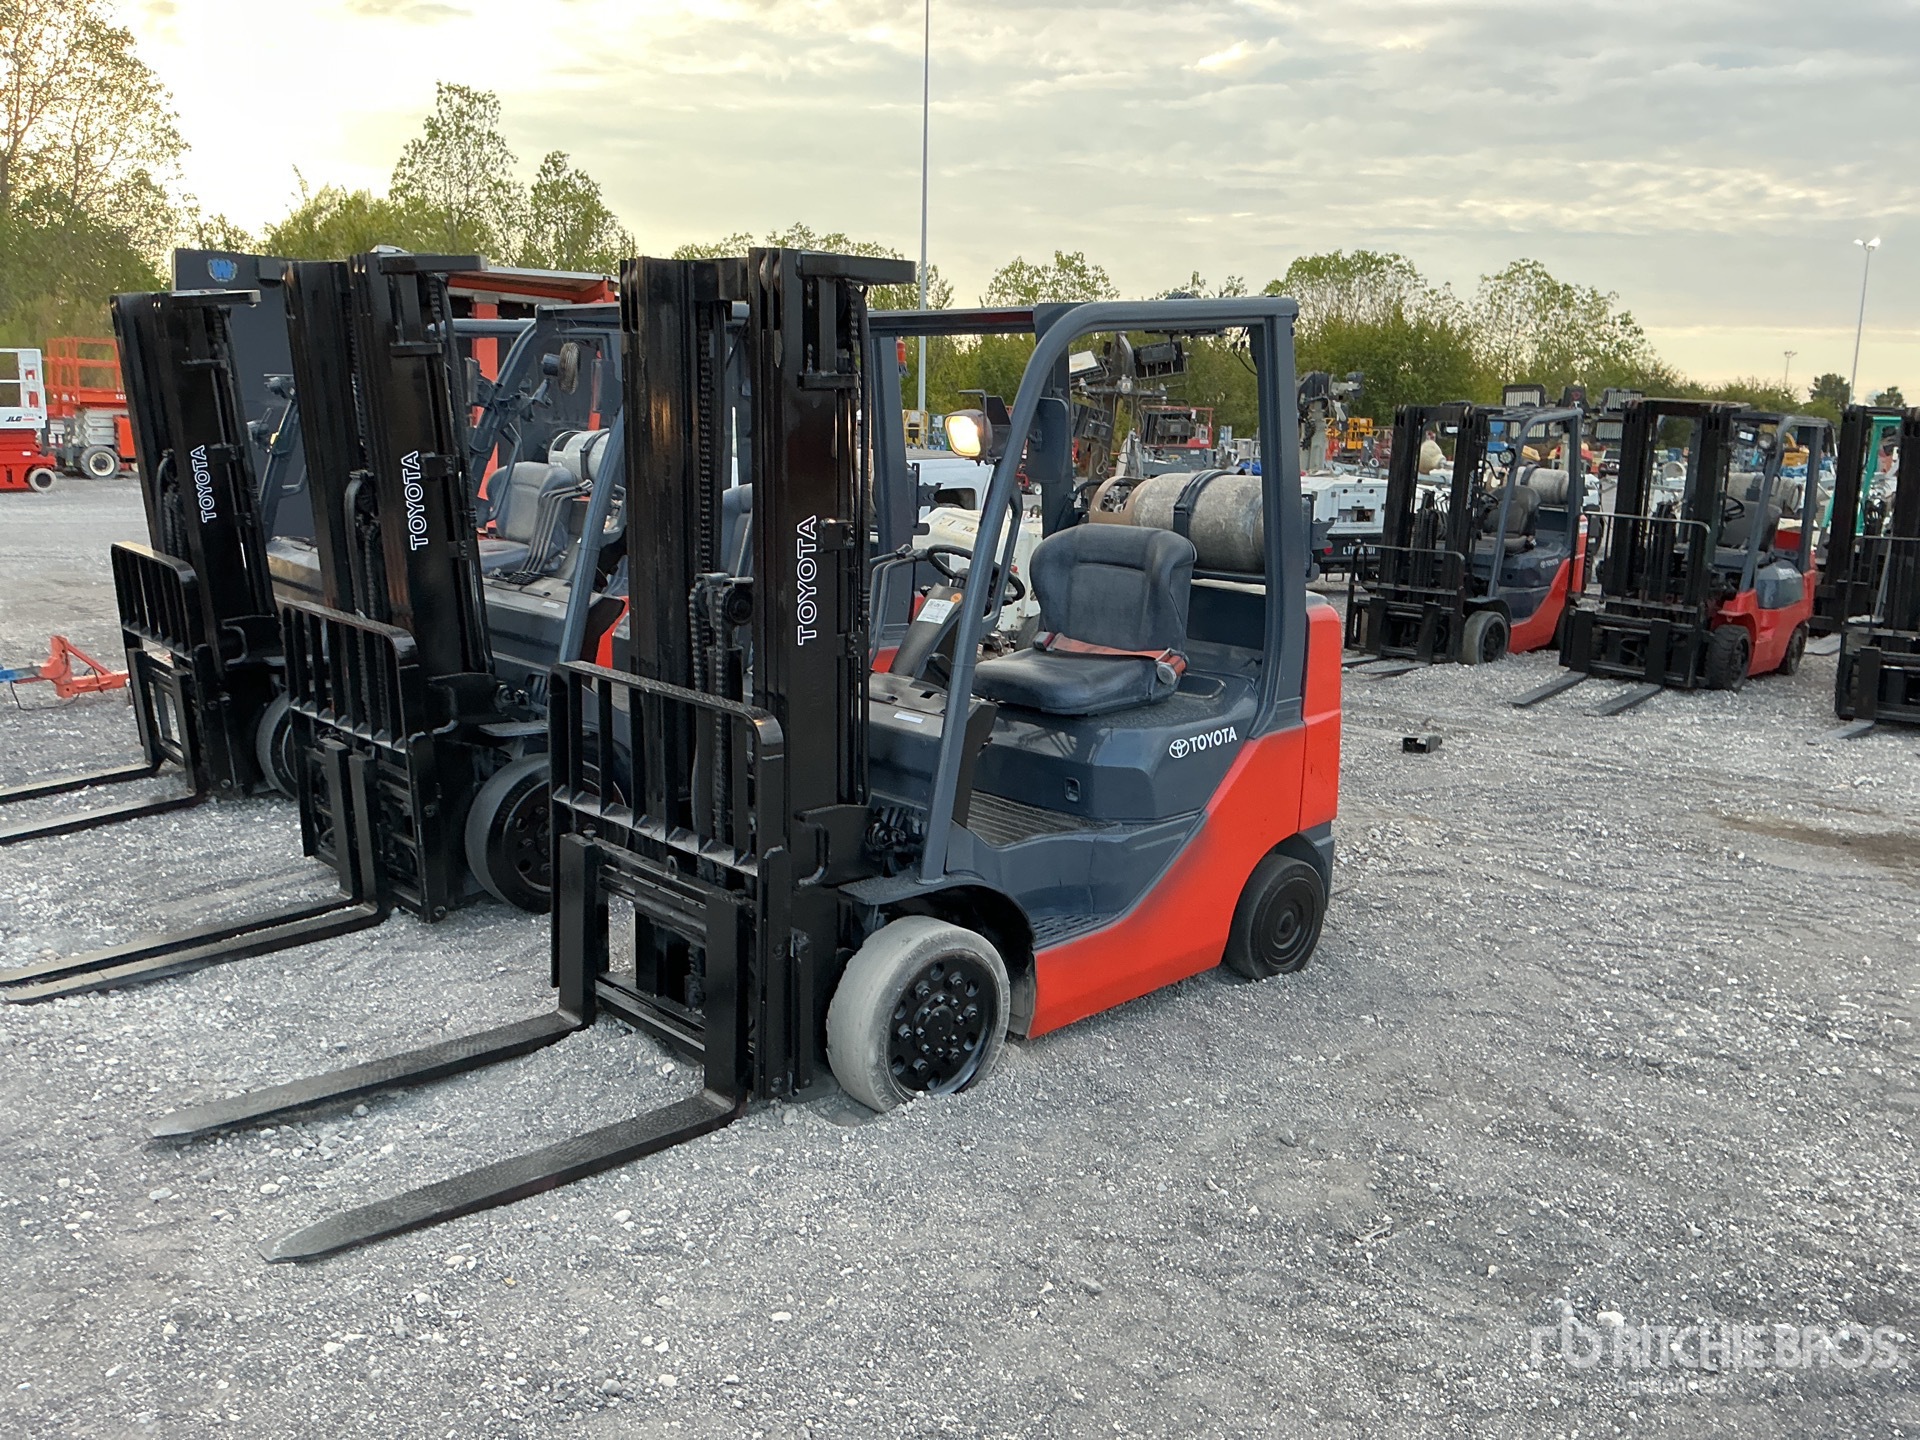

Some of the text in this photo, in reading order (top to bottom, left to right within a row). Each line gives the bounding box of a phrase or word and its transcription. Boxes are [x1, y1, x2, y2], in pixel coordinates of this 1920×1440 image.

[190, 444, 217, 523] TOYOTA
[401, 450, 429, 551] TOYOTA
[797, 515, 817, 646] TOYOTA
[1189, 726, 1238, 753] TOYOTA
